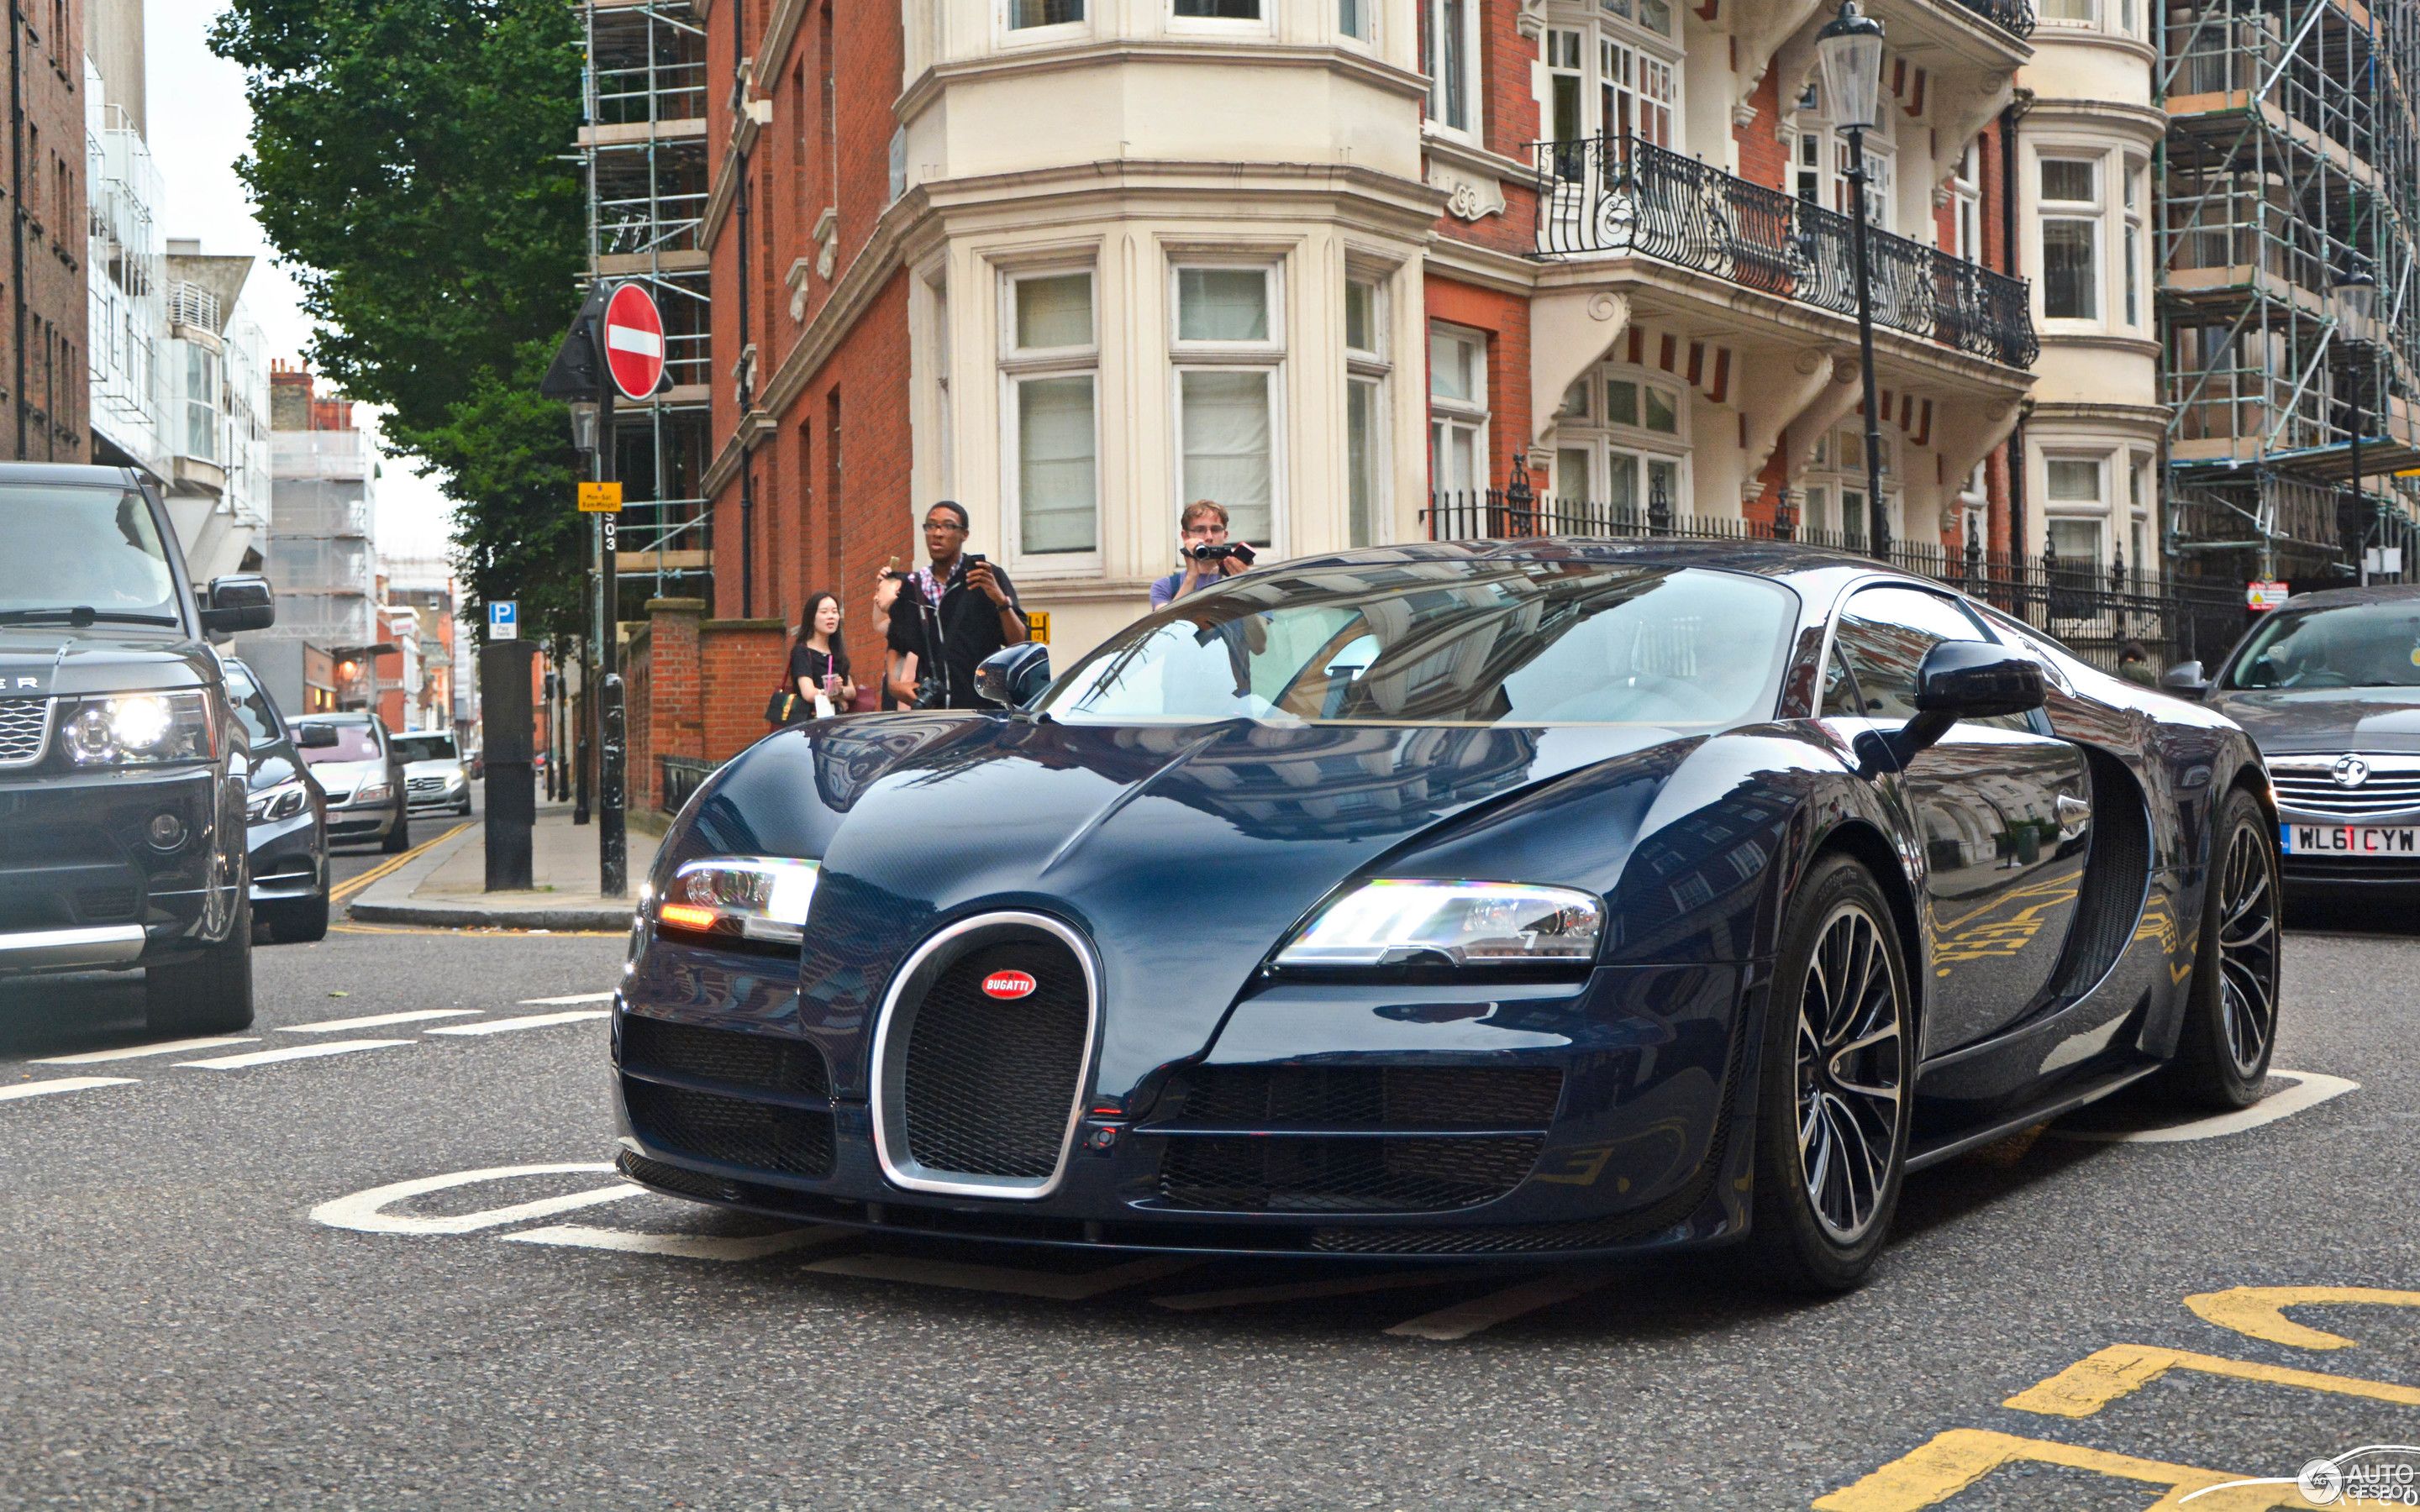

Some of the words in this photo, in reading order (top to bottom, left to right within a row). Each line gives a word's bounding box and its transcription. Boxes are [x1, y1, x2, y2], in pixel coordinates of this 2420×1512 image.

[495, 604, 512, 623] P
[2299, 827, 2354, 851] WL61
[2363, 829, 2414, 851] CYW
[986, 979, 1029, 991] BUGATTI
